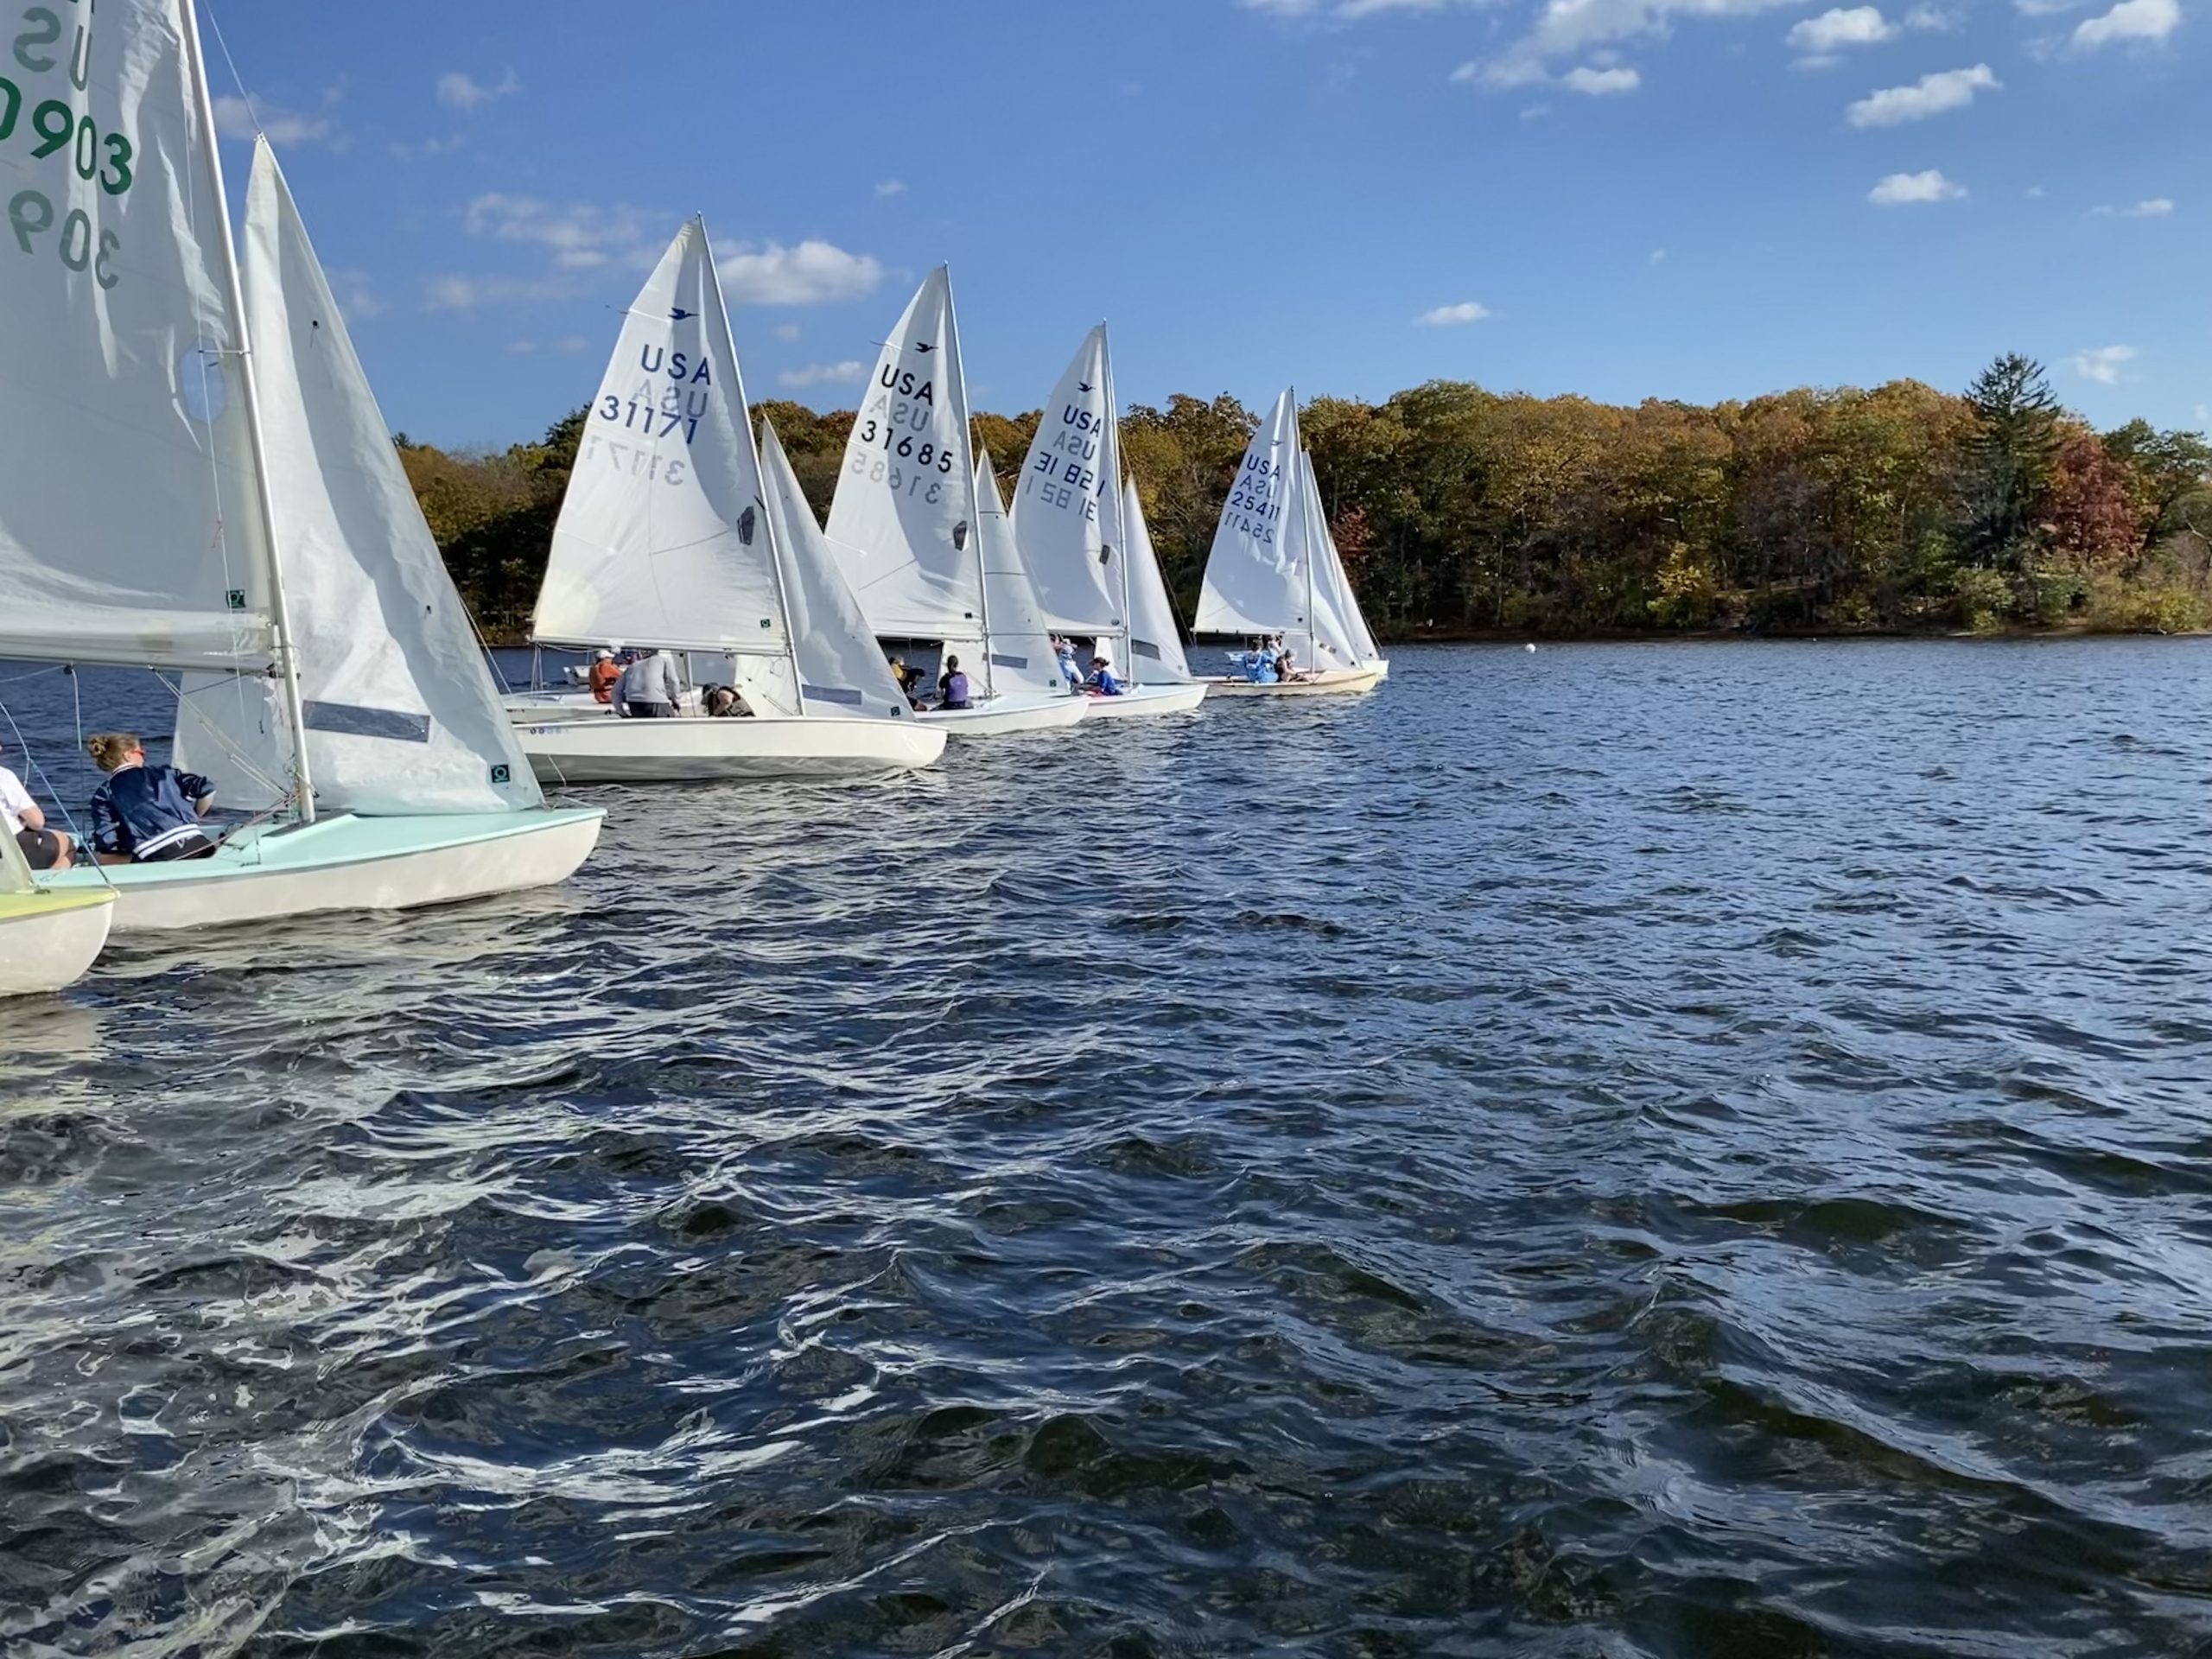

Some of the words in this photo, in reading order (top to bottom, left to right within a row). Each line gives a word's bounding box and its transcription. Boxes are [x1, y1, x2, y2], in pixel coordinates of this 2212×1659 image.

[640, 344, 711, 385] USA
[881, 364, 933, 406] USA
[600, 395, 698, 444] 31171
[1063, 404, 1101, 437] USA
[861, 420, 953, 473] 31685
[1247, 454, 1281, 480] USA
[1231, 491, 1281, 521] 25411
